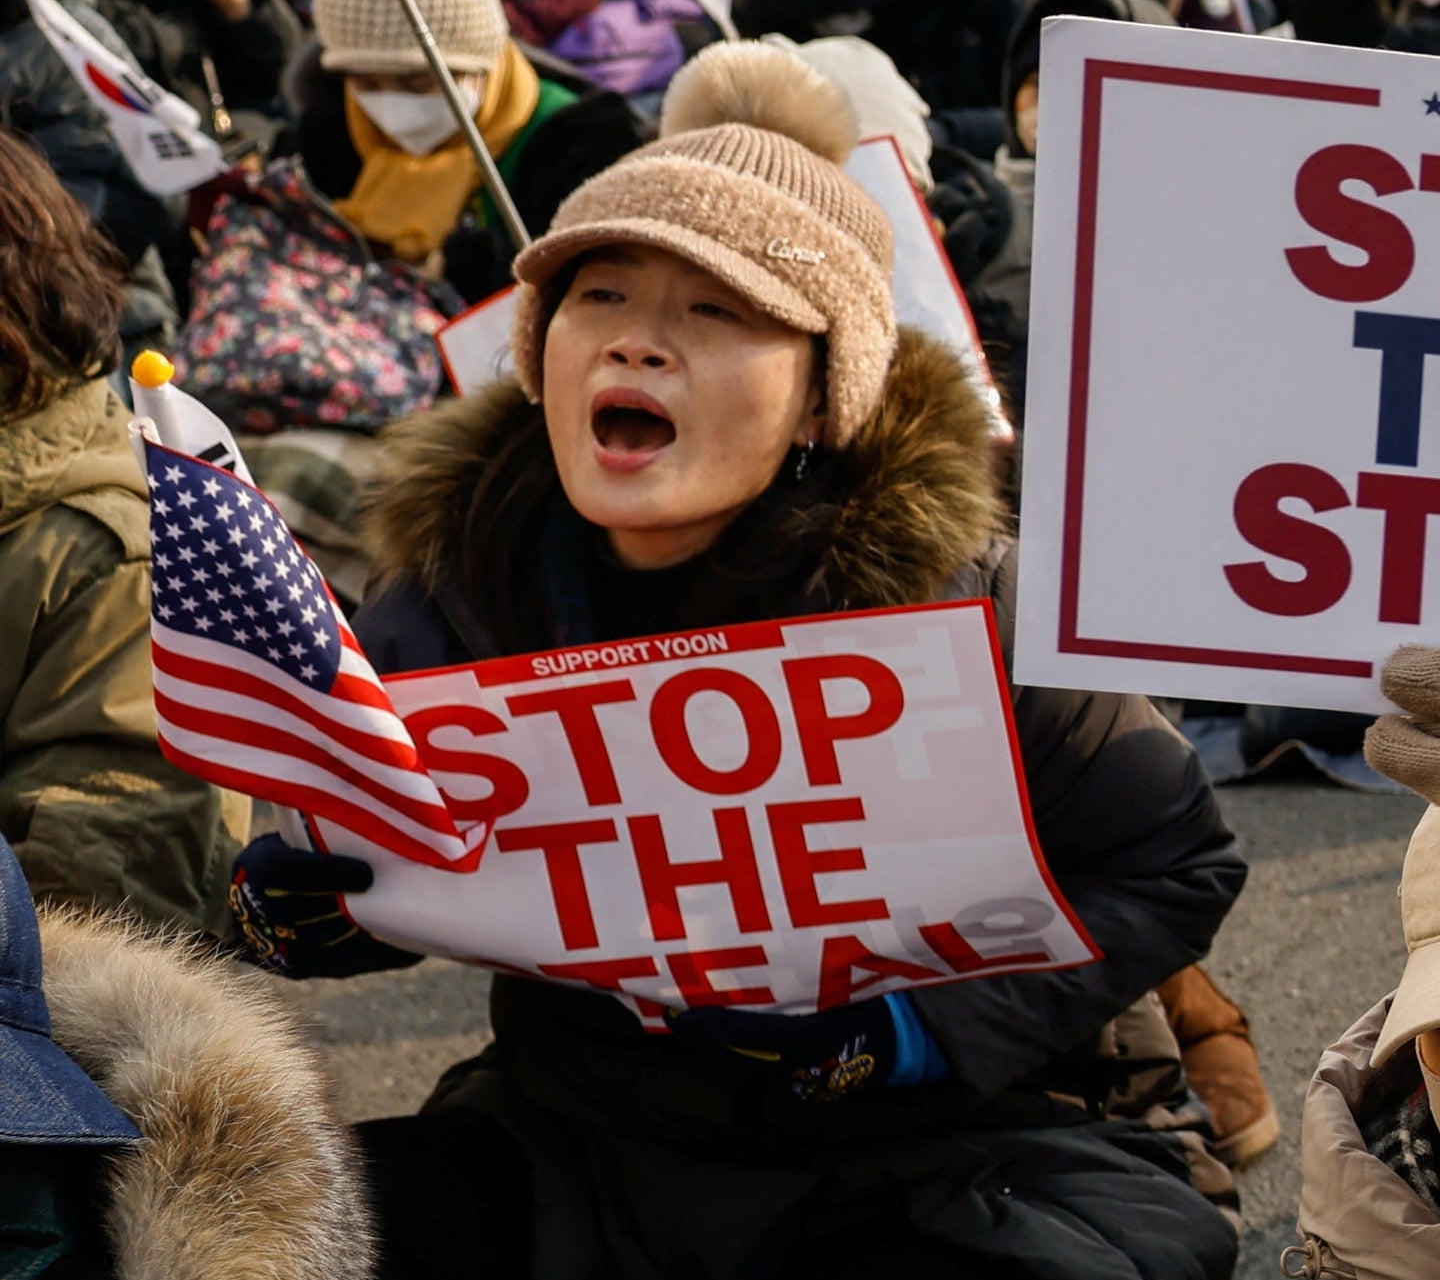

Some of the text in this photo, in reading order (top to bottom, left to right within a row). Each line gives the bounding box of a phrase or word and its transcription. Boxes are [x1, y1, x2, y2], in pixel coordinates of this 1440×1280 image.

[531, 631, 729, 679] SUPPORT YOON
[403, 653, 905, 822] STOP
[495, 796, 890, 951] THE
[539, 921, 1051, 1021] TEAL
